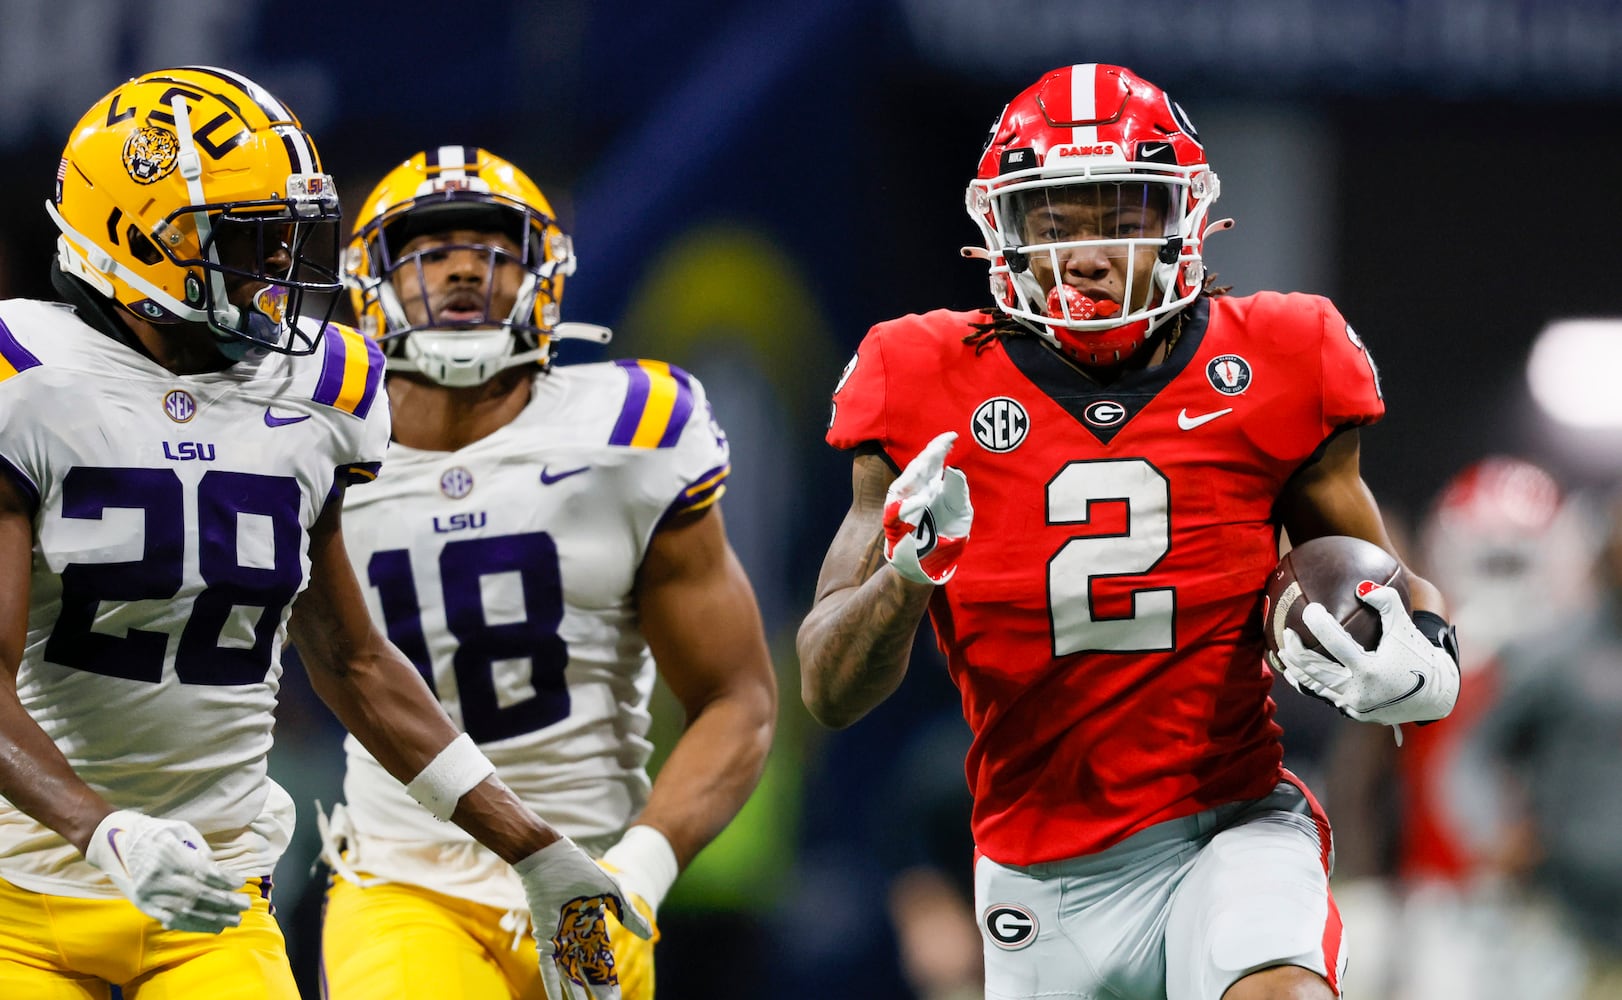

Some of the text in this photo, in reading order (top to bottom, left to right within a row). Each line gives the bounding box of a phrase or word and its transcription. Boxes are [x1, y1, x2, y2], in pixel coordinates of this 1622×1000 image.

[106, 87, 247, 160] LSU
[1008, 152, 1025, 163] NIKE
[1059, 145, 1114, 157] DAWGS
[166, 391, 194, 420] SEC
[976, 401, 1024, 449] SEC
[162, 441, 216, 461] LSU
[432, 511, 487, 533] LSU
[1046, 458, 1176, 658] 2
[43, 466, 303, 686] 28
[367, 531, 573, 744] 18
[986, 908, 1033, 943] G
